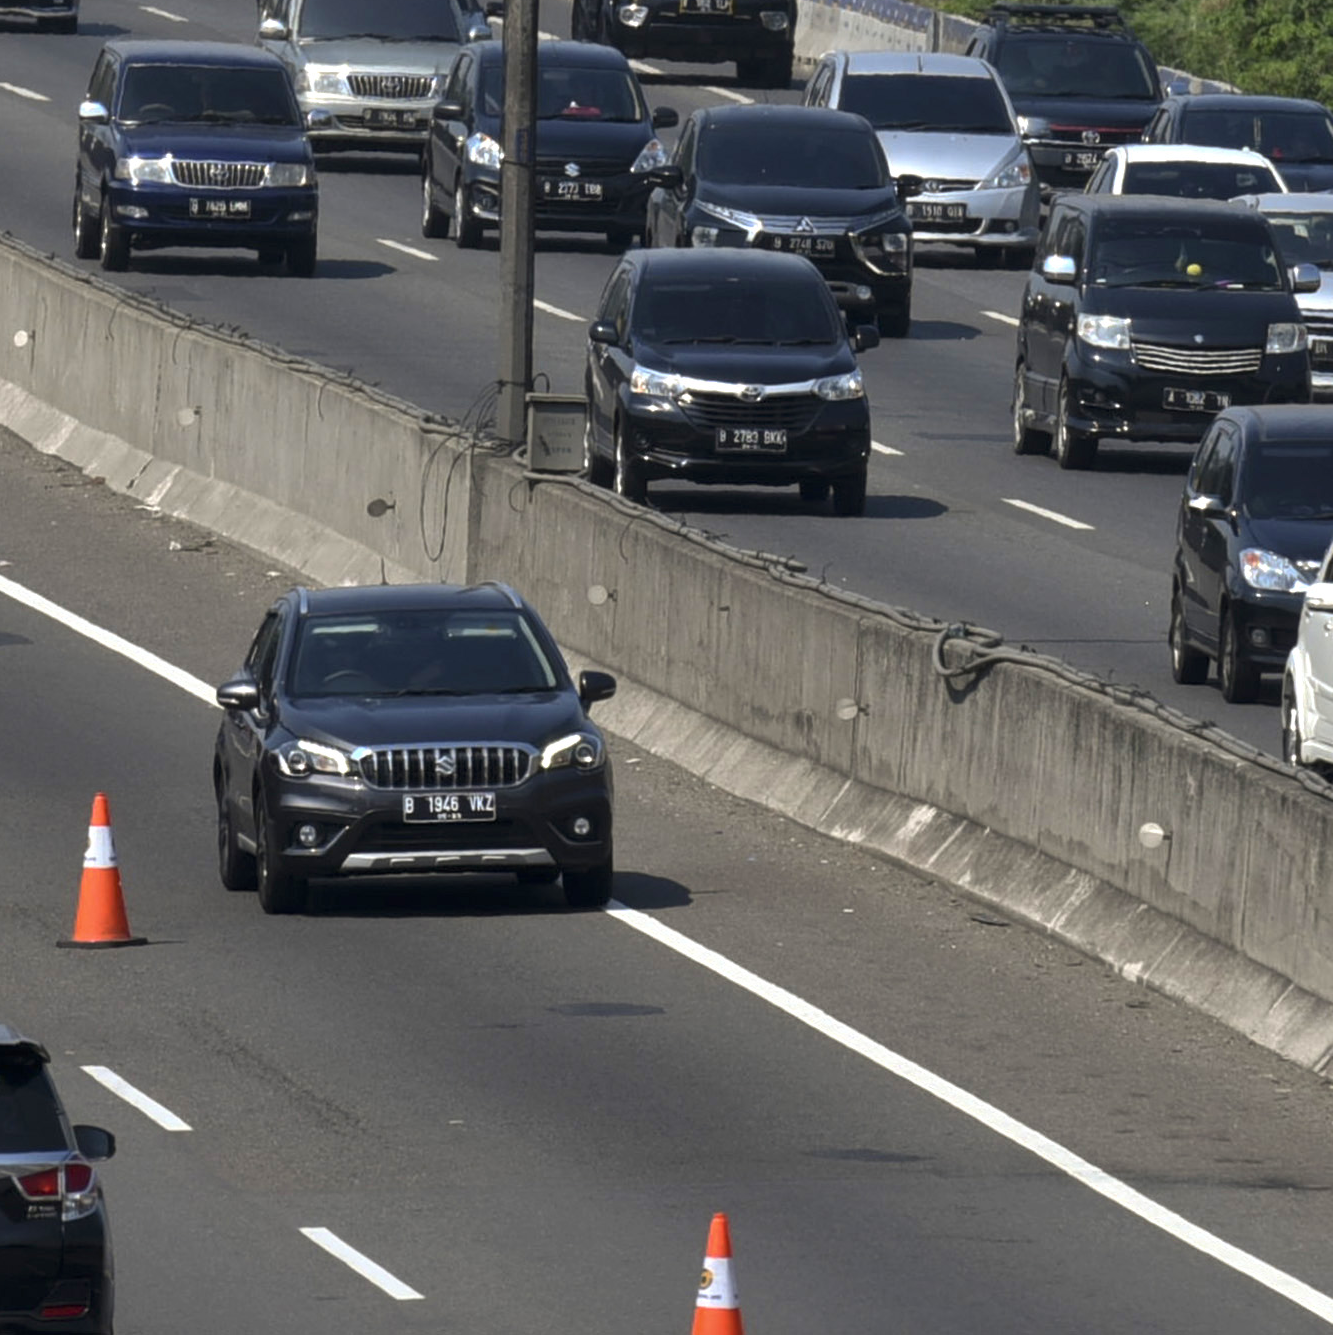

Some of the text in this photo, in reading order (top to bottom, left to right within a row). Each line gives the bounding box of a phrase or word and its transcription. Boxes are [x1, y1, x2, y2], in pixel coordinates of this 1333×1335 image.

[405, 794, 494, 814] B 1946 VKZ
